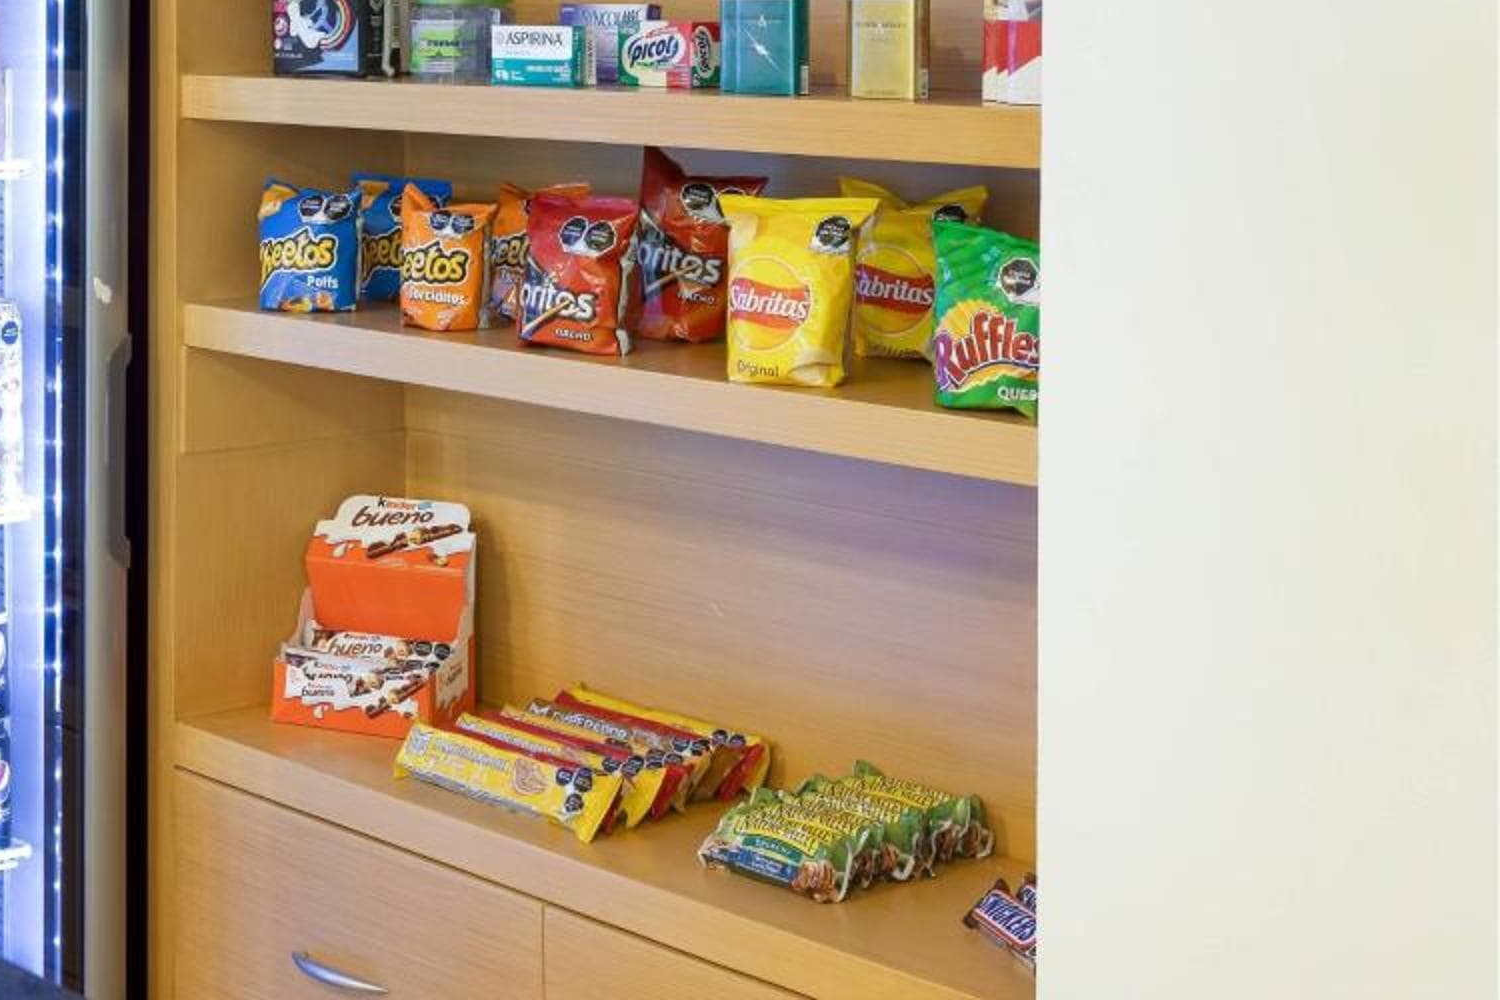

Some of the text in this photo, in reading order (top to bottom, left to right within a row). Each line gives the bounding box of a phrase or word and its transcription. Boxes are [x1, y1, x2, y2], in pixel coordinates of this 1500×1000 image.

[505, 31, 565, 47] ASPIRINA
[637, 242, 722, 286] oritos
[519, 280, 596, 320] oritos
[729, 284, 809, 320] Sabritas
[352, 506, 436, 528] bueno
